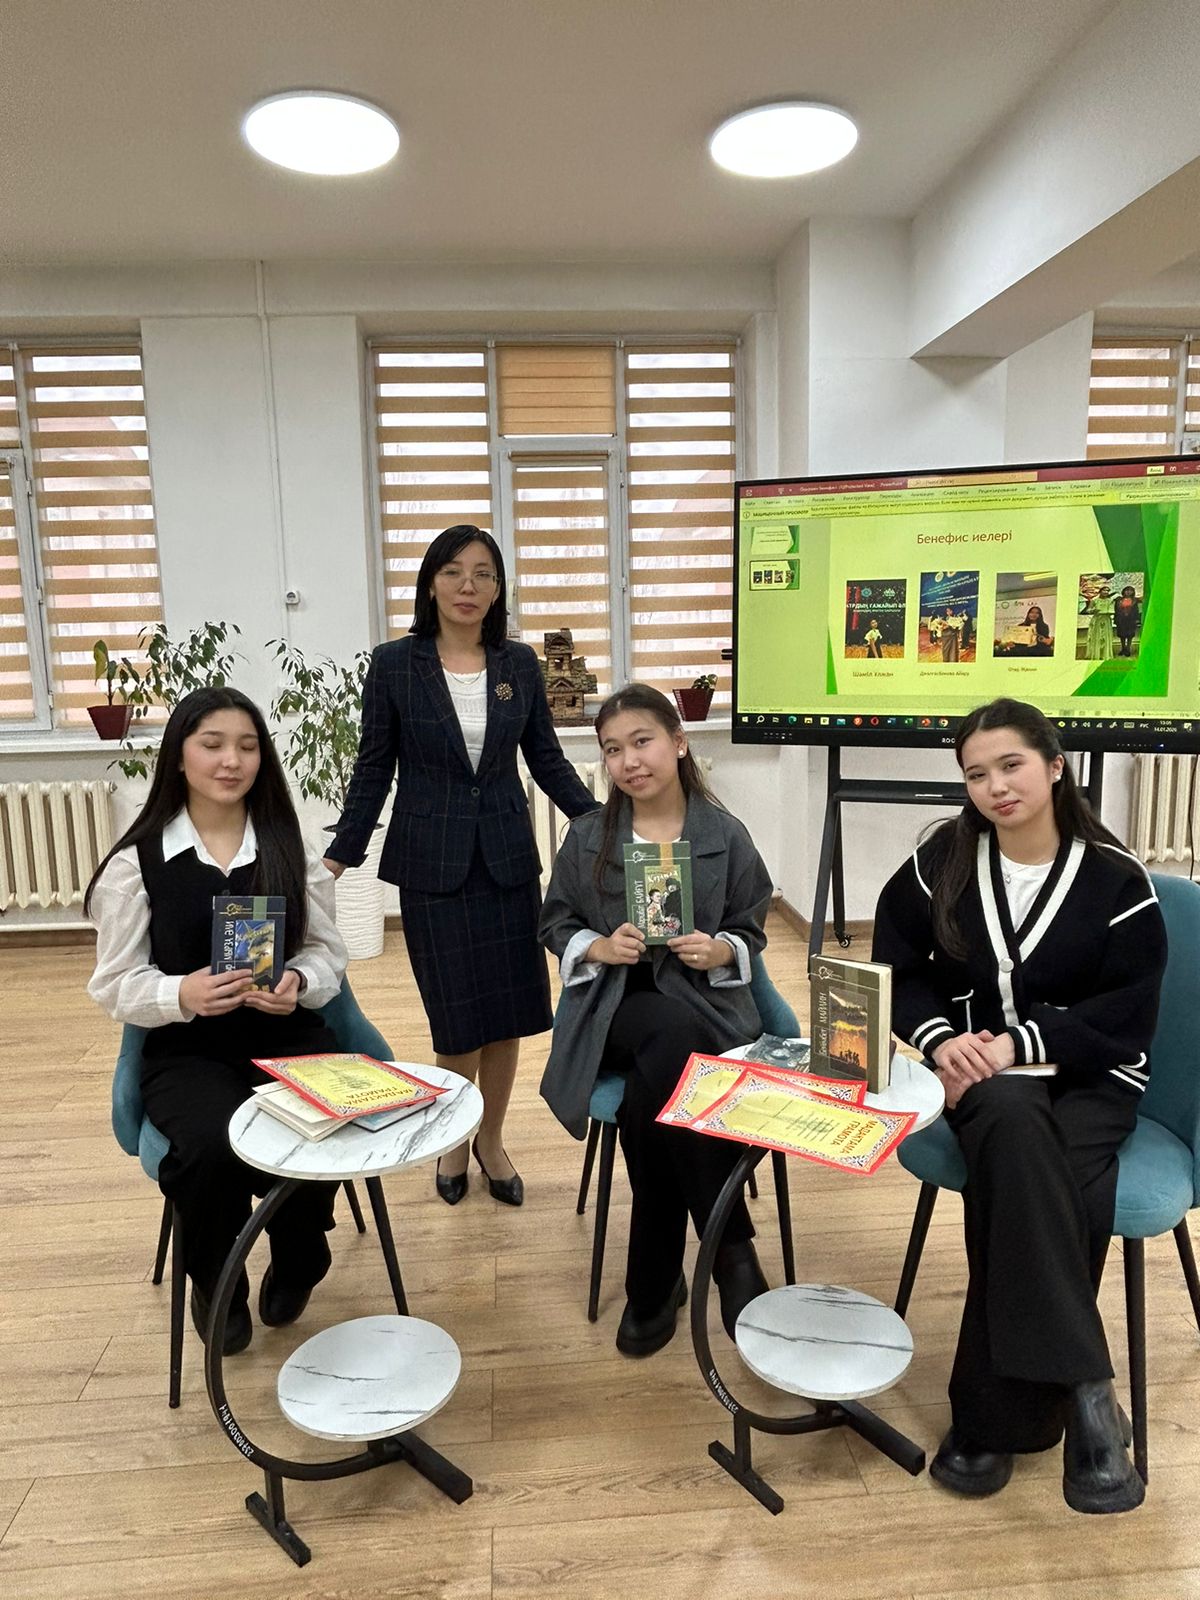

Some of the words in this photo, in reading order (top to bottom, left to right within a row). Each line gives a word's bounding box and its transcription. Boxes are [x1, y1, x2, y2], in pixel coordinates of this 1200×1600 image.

[917, 533, 969, 545] Бенефис
[971, 530, 1012, 543] иелері
[830, 1120, 861, 1146] ГРАМОТА
